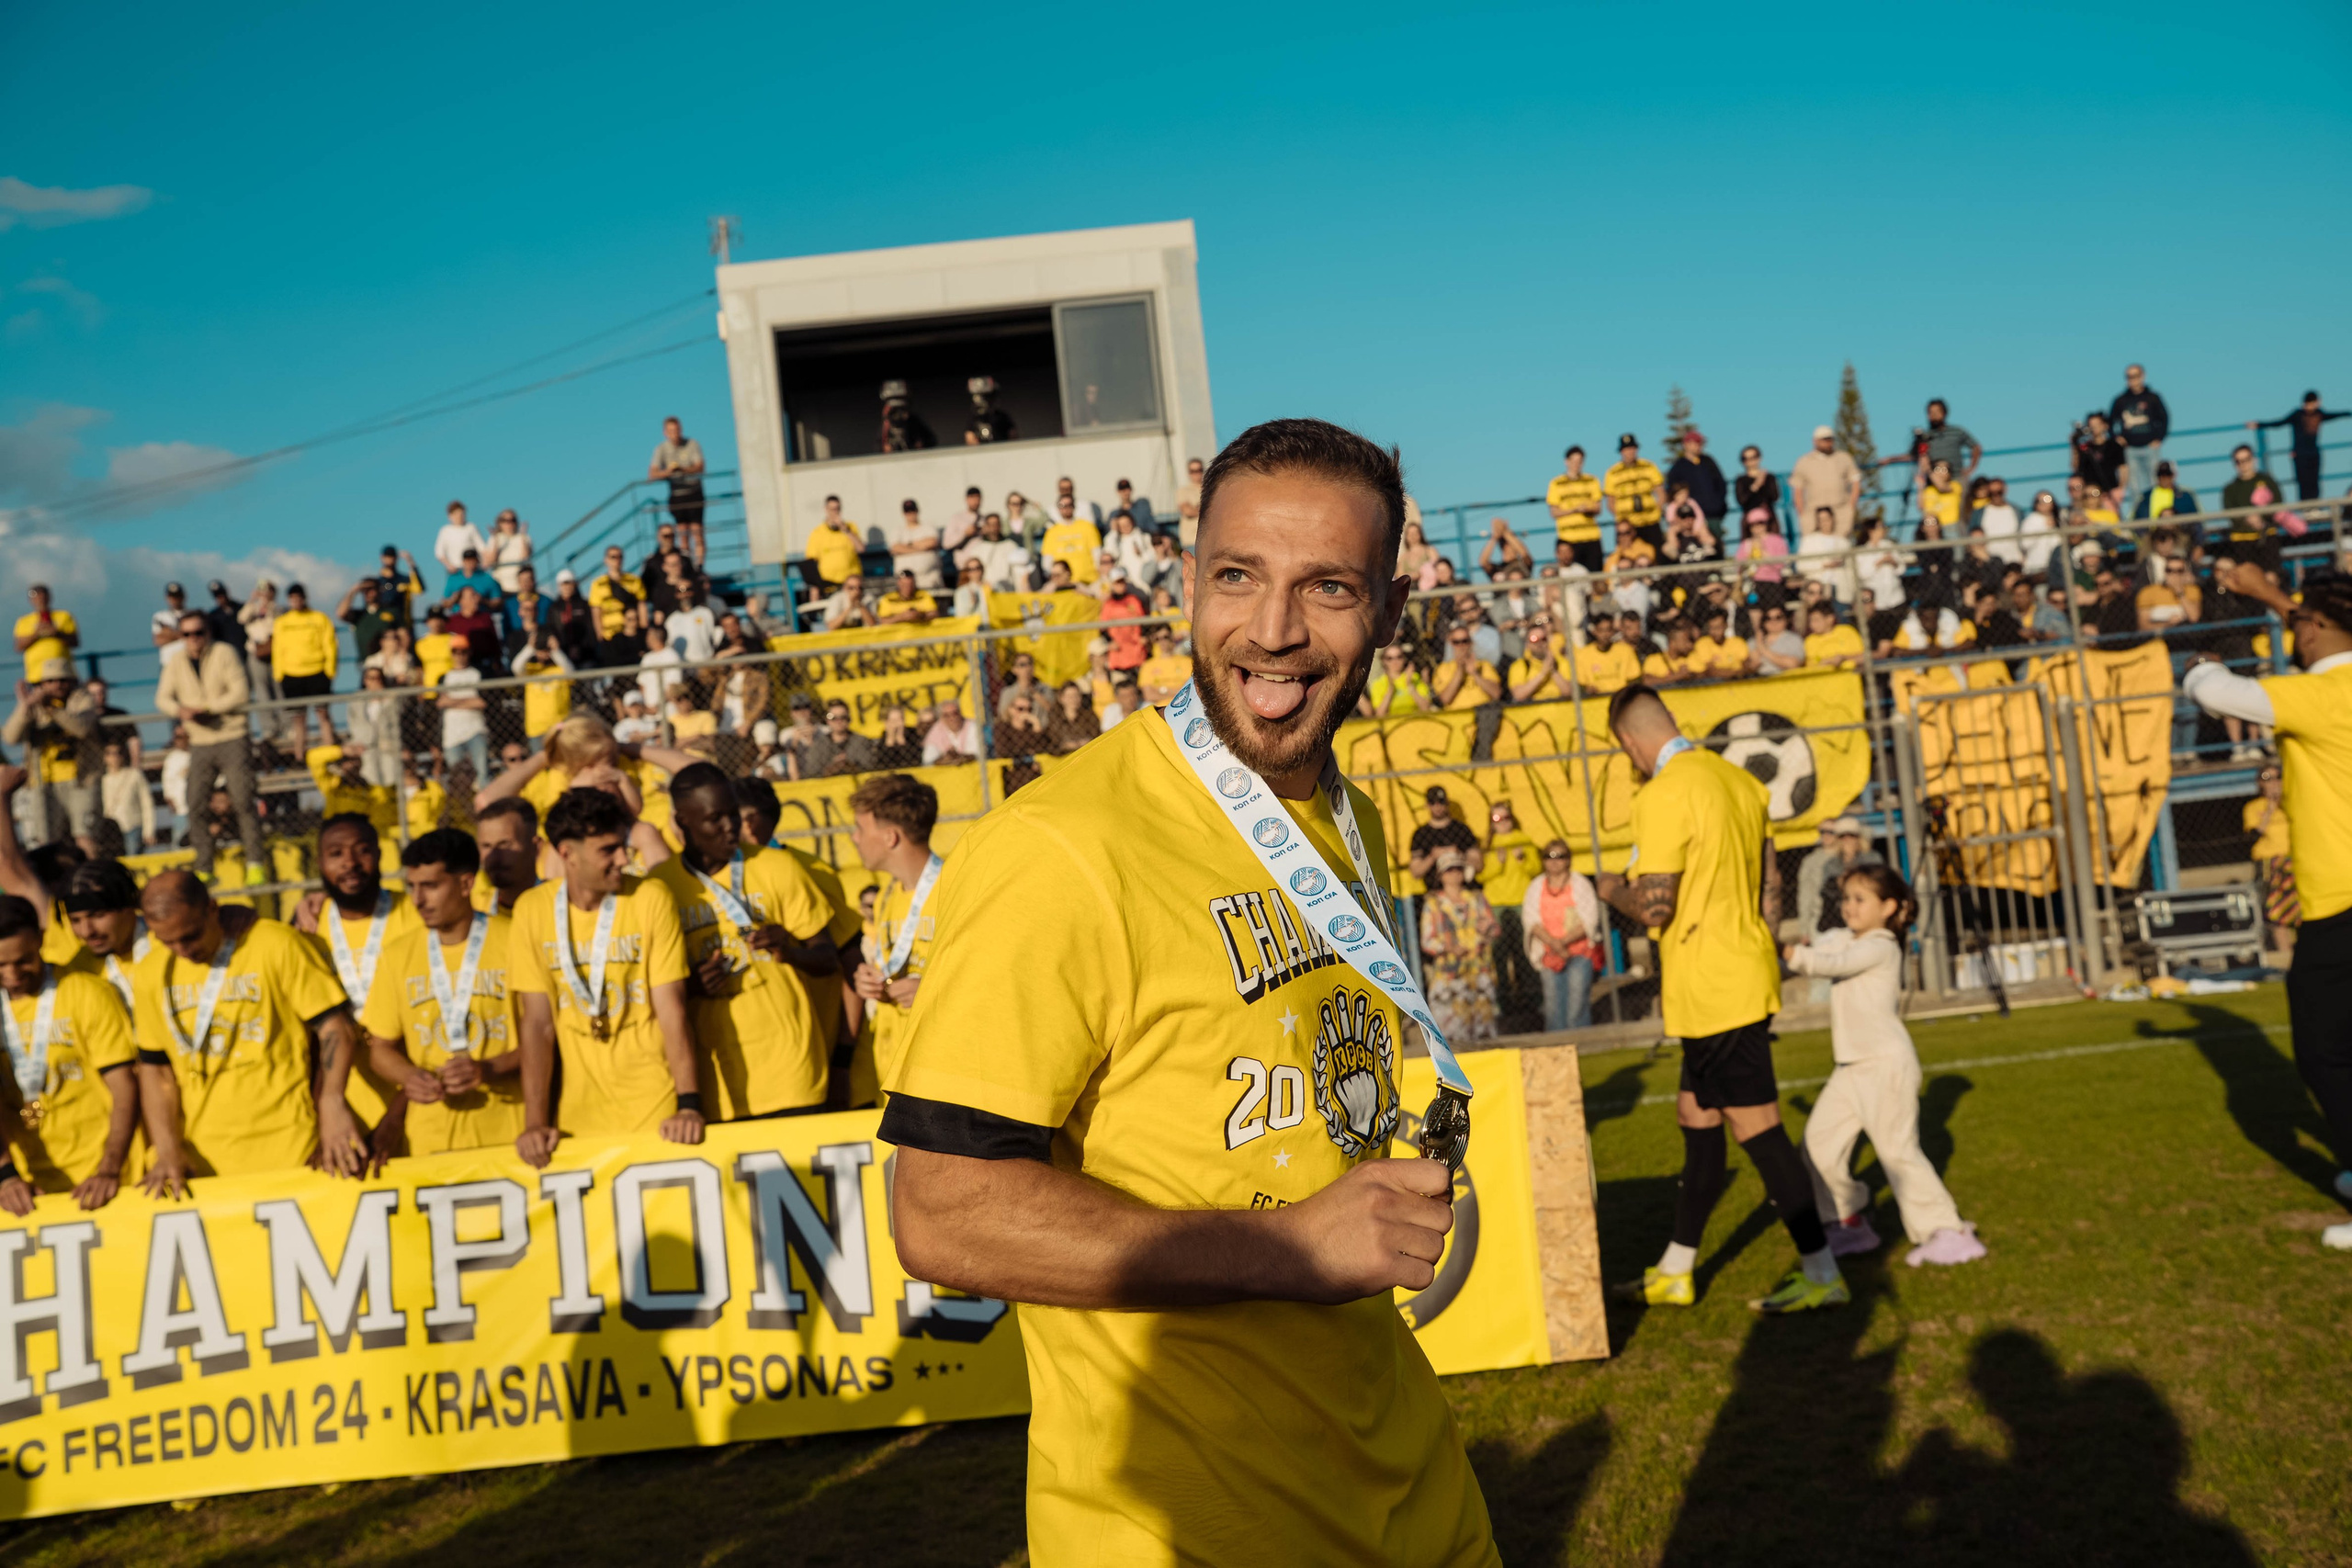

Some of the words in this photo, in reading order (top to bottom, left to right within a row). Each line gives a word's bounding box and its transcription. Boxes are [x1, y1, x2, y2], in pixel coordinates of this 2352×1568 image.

[1250, 793, 1262, 803] CFA
[1286, 842, 1300, 852] CFA
[1324, 891, 1338, 901] CFA
[1363, 940, 1377, 948] CFA
[1224, 1056, 1305, 1151] 20
[0, 1141, 1009, 1426] HAMPION
[63, 1390, 299, 1474] FREEDOM
[312, 1380, 370, 1445] 24
[405, 1358, 627, 1438] KRASAVA
[661, 1354, 896, 1410] YPSONAS
